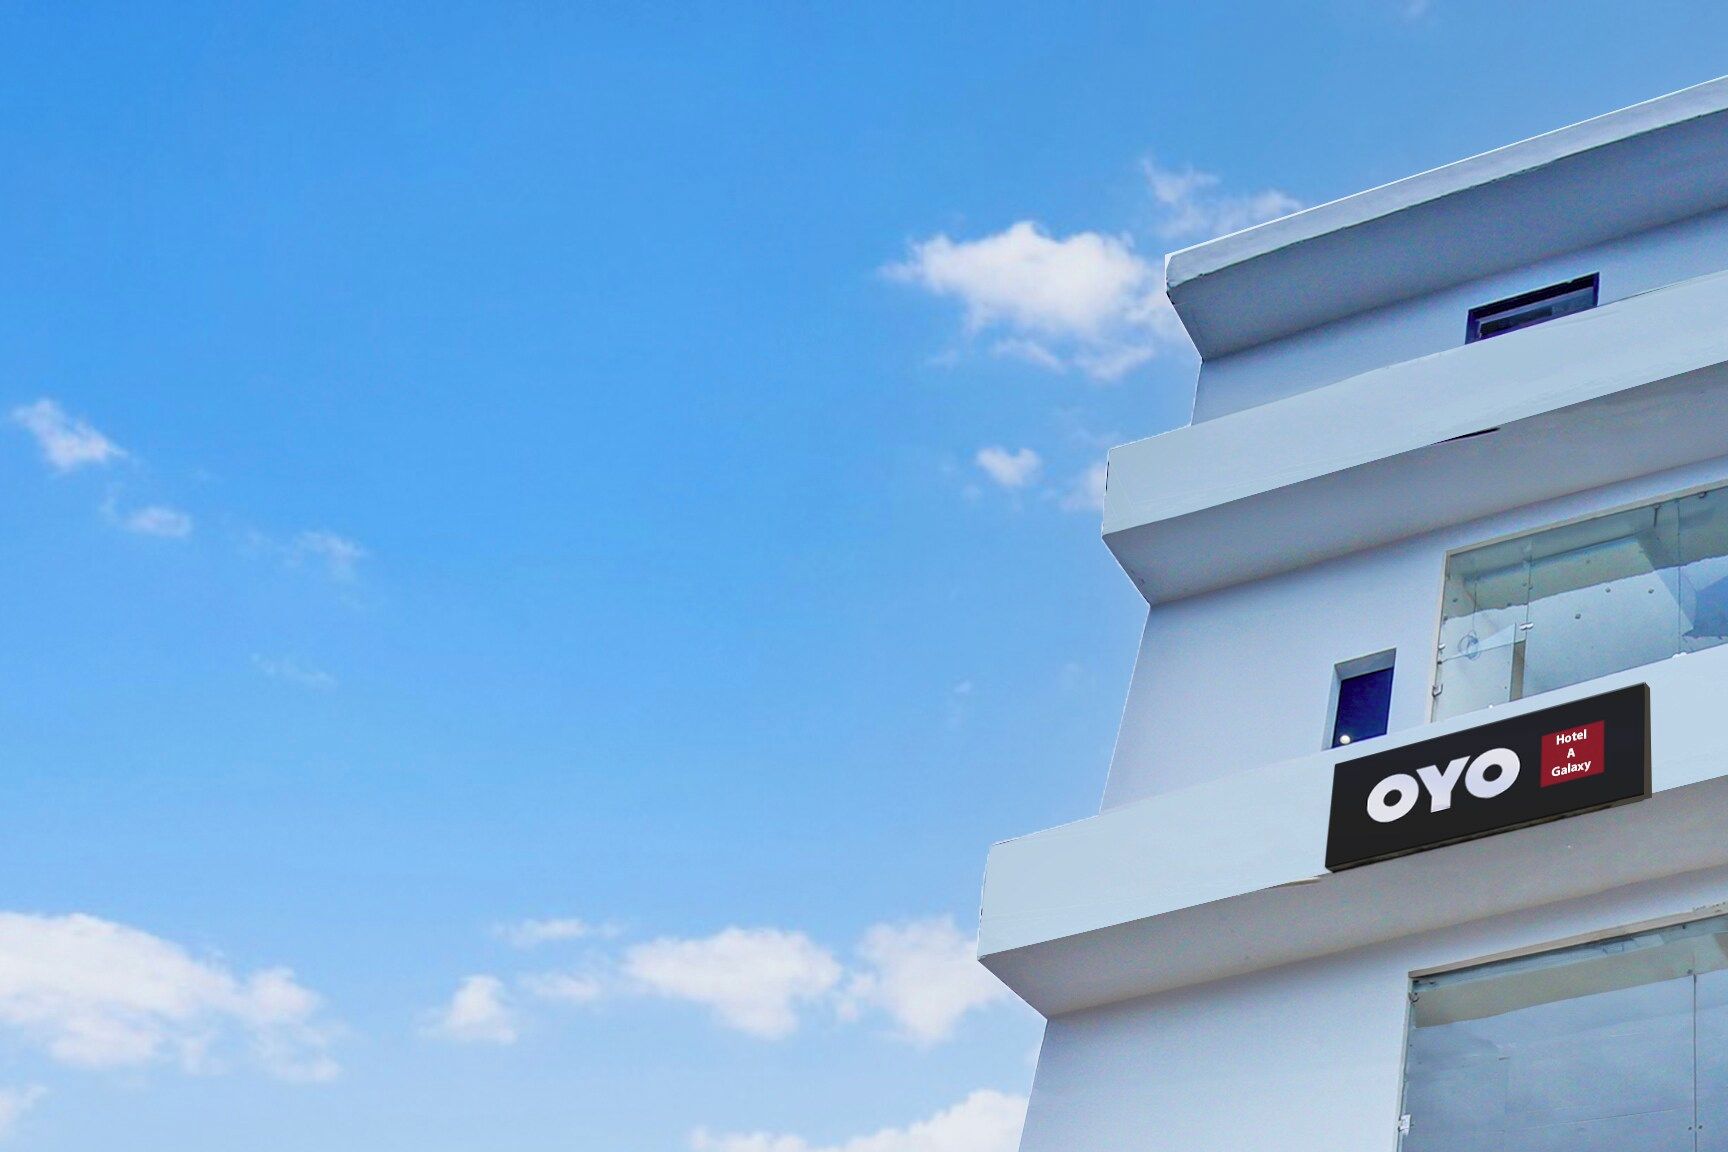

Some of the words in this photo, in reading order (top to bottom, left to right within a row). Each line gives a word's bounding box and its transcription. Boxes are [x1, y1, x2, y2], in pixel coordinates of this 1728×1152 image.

[1556, 729, 1587, 745] Hotel
[1566, 748, 1576, 759] A
[1551, 759, 1592, 777] Galaxy
[1366, 747, 1521, 823] OYO
